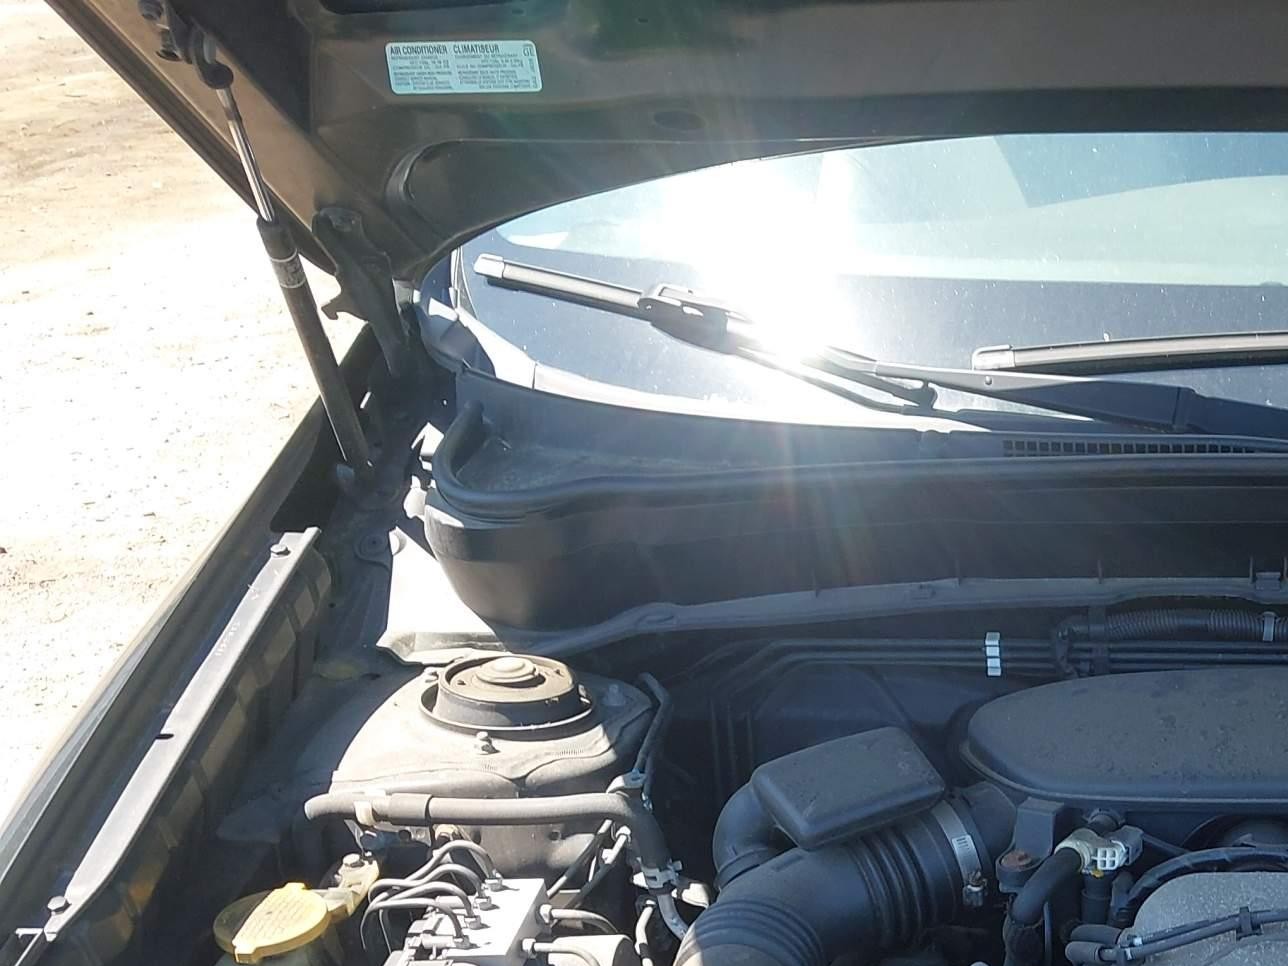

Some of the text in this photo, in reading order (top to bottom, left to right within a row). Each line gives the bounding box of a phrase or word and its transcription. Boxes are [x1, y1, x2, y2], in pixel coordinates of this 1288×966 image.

[390, 45, 448, 55] AIR CONDITIONER
[453, 43, 500, 54] CLIMATISEUR
